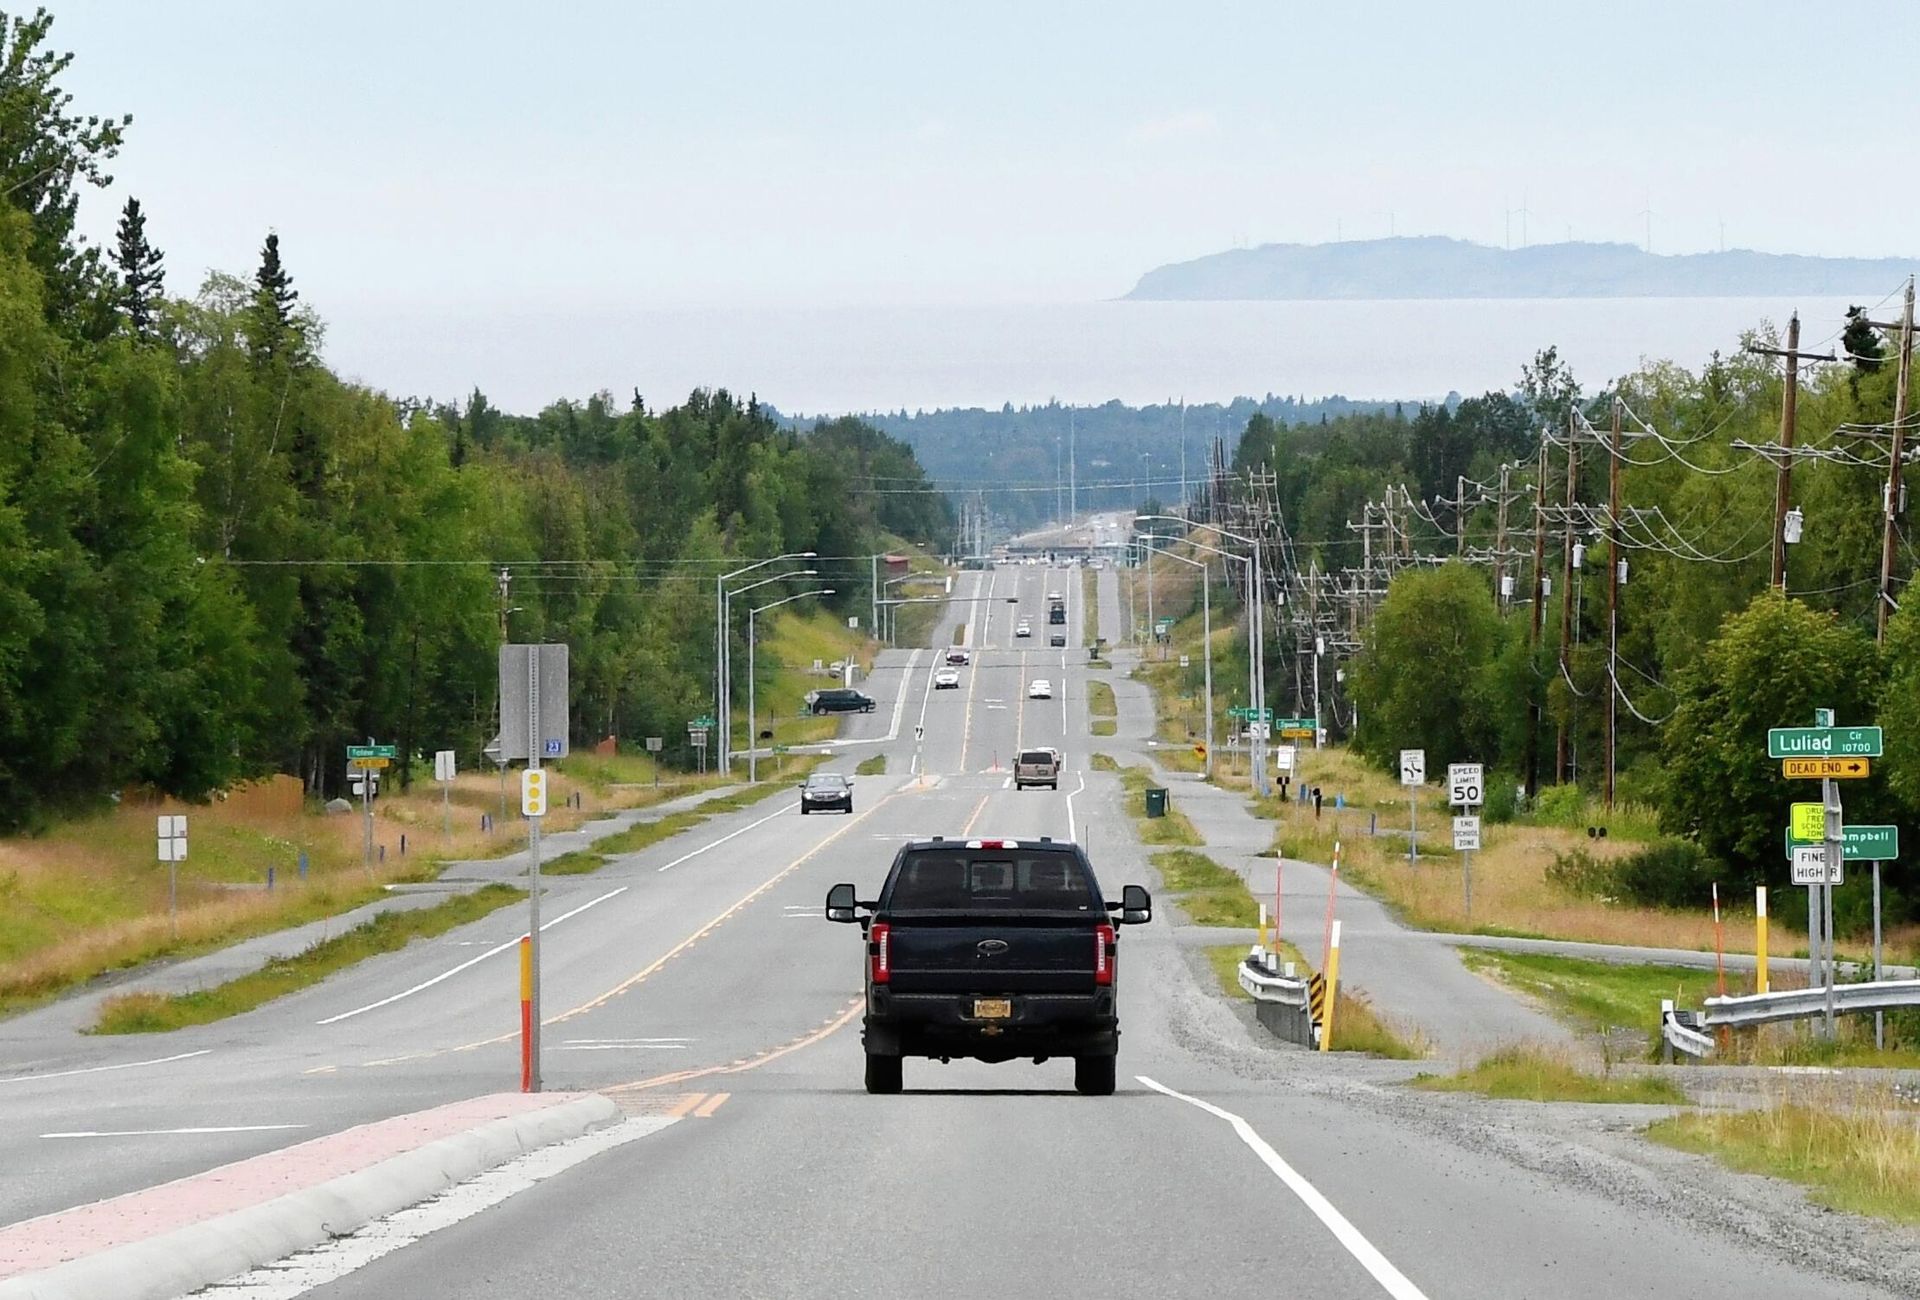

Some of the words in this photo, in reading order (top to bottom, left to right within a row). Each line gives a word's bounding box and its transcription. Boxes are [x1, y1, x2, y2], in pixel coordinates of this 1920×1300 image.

[1780, 734, 1832, 751] Luliad
[1849, 731, 1862, 740] Cir
[548, 742, 559, 752] 23
[1842, 743, 1871, 752] 10700
[1452, 767, 1479, 775] SPEED
[1790, 762, 1817, 774] DEAD
[1821, 762, 1842, 774] END
[1454, 786, 1479, 801] 50
[1801, 822, 1825, 830] SCHO
[1841, 832, 1888, 842] ampbell
[1459, 839, 1475, 847] ZONE
[1801, 853, 1825, 862] FINE
[1797, 867, 1837, 877] HIGHR
